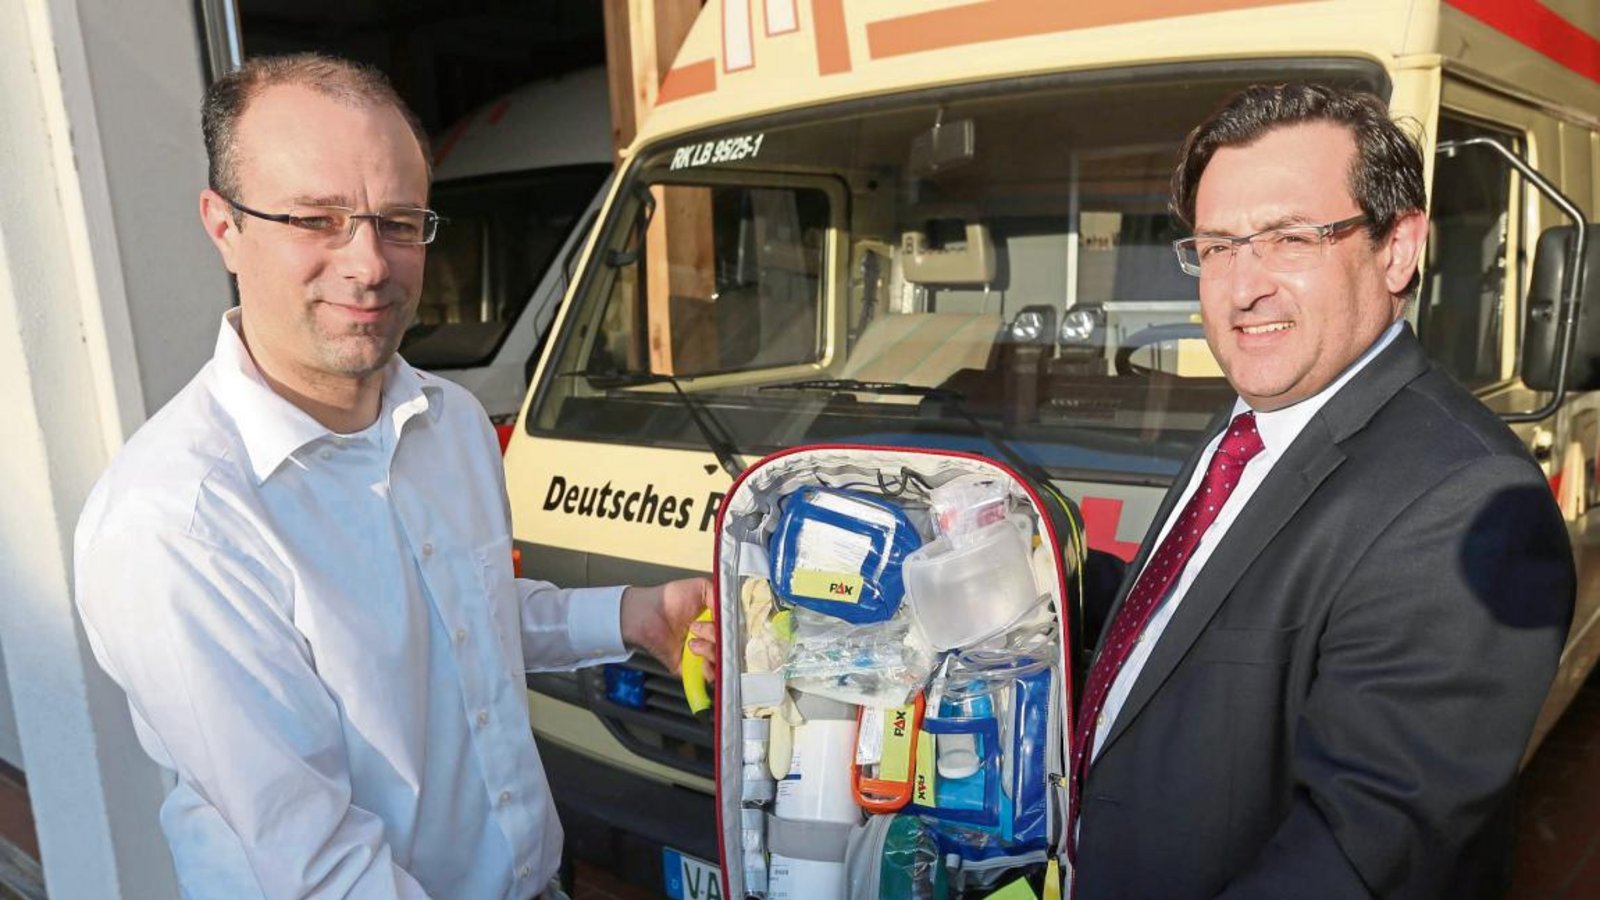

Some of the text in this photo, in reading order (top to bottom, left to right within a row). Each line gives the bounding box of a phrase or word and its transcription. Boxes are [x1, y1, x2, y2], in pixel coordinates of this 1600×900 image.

[670, 145, 695, 170] RK
[691, 142, 714, 166] LB
[543, 475, 694, 529] Deutsches
[829, 582, 854, 596] PAX
[894, 711, 906, 736] PAX
[918, 774, 927, 800] PAX
